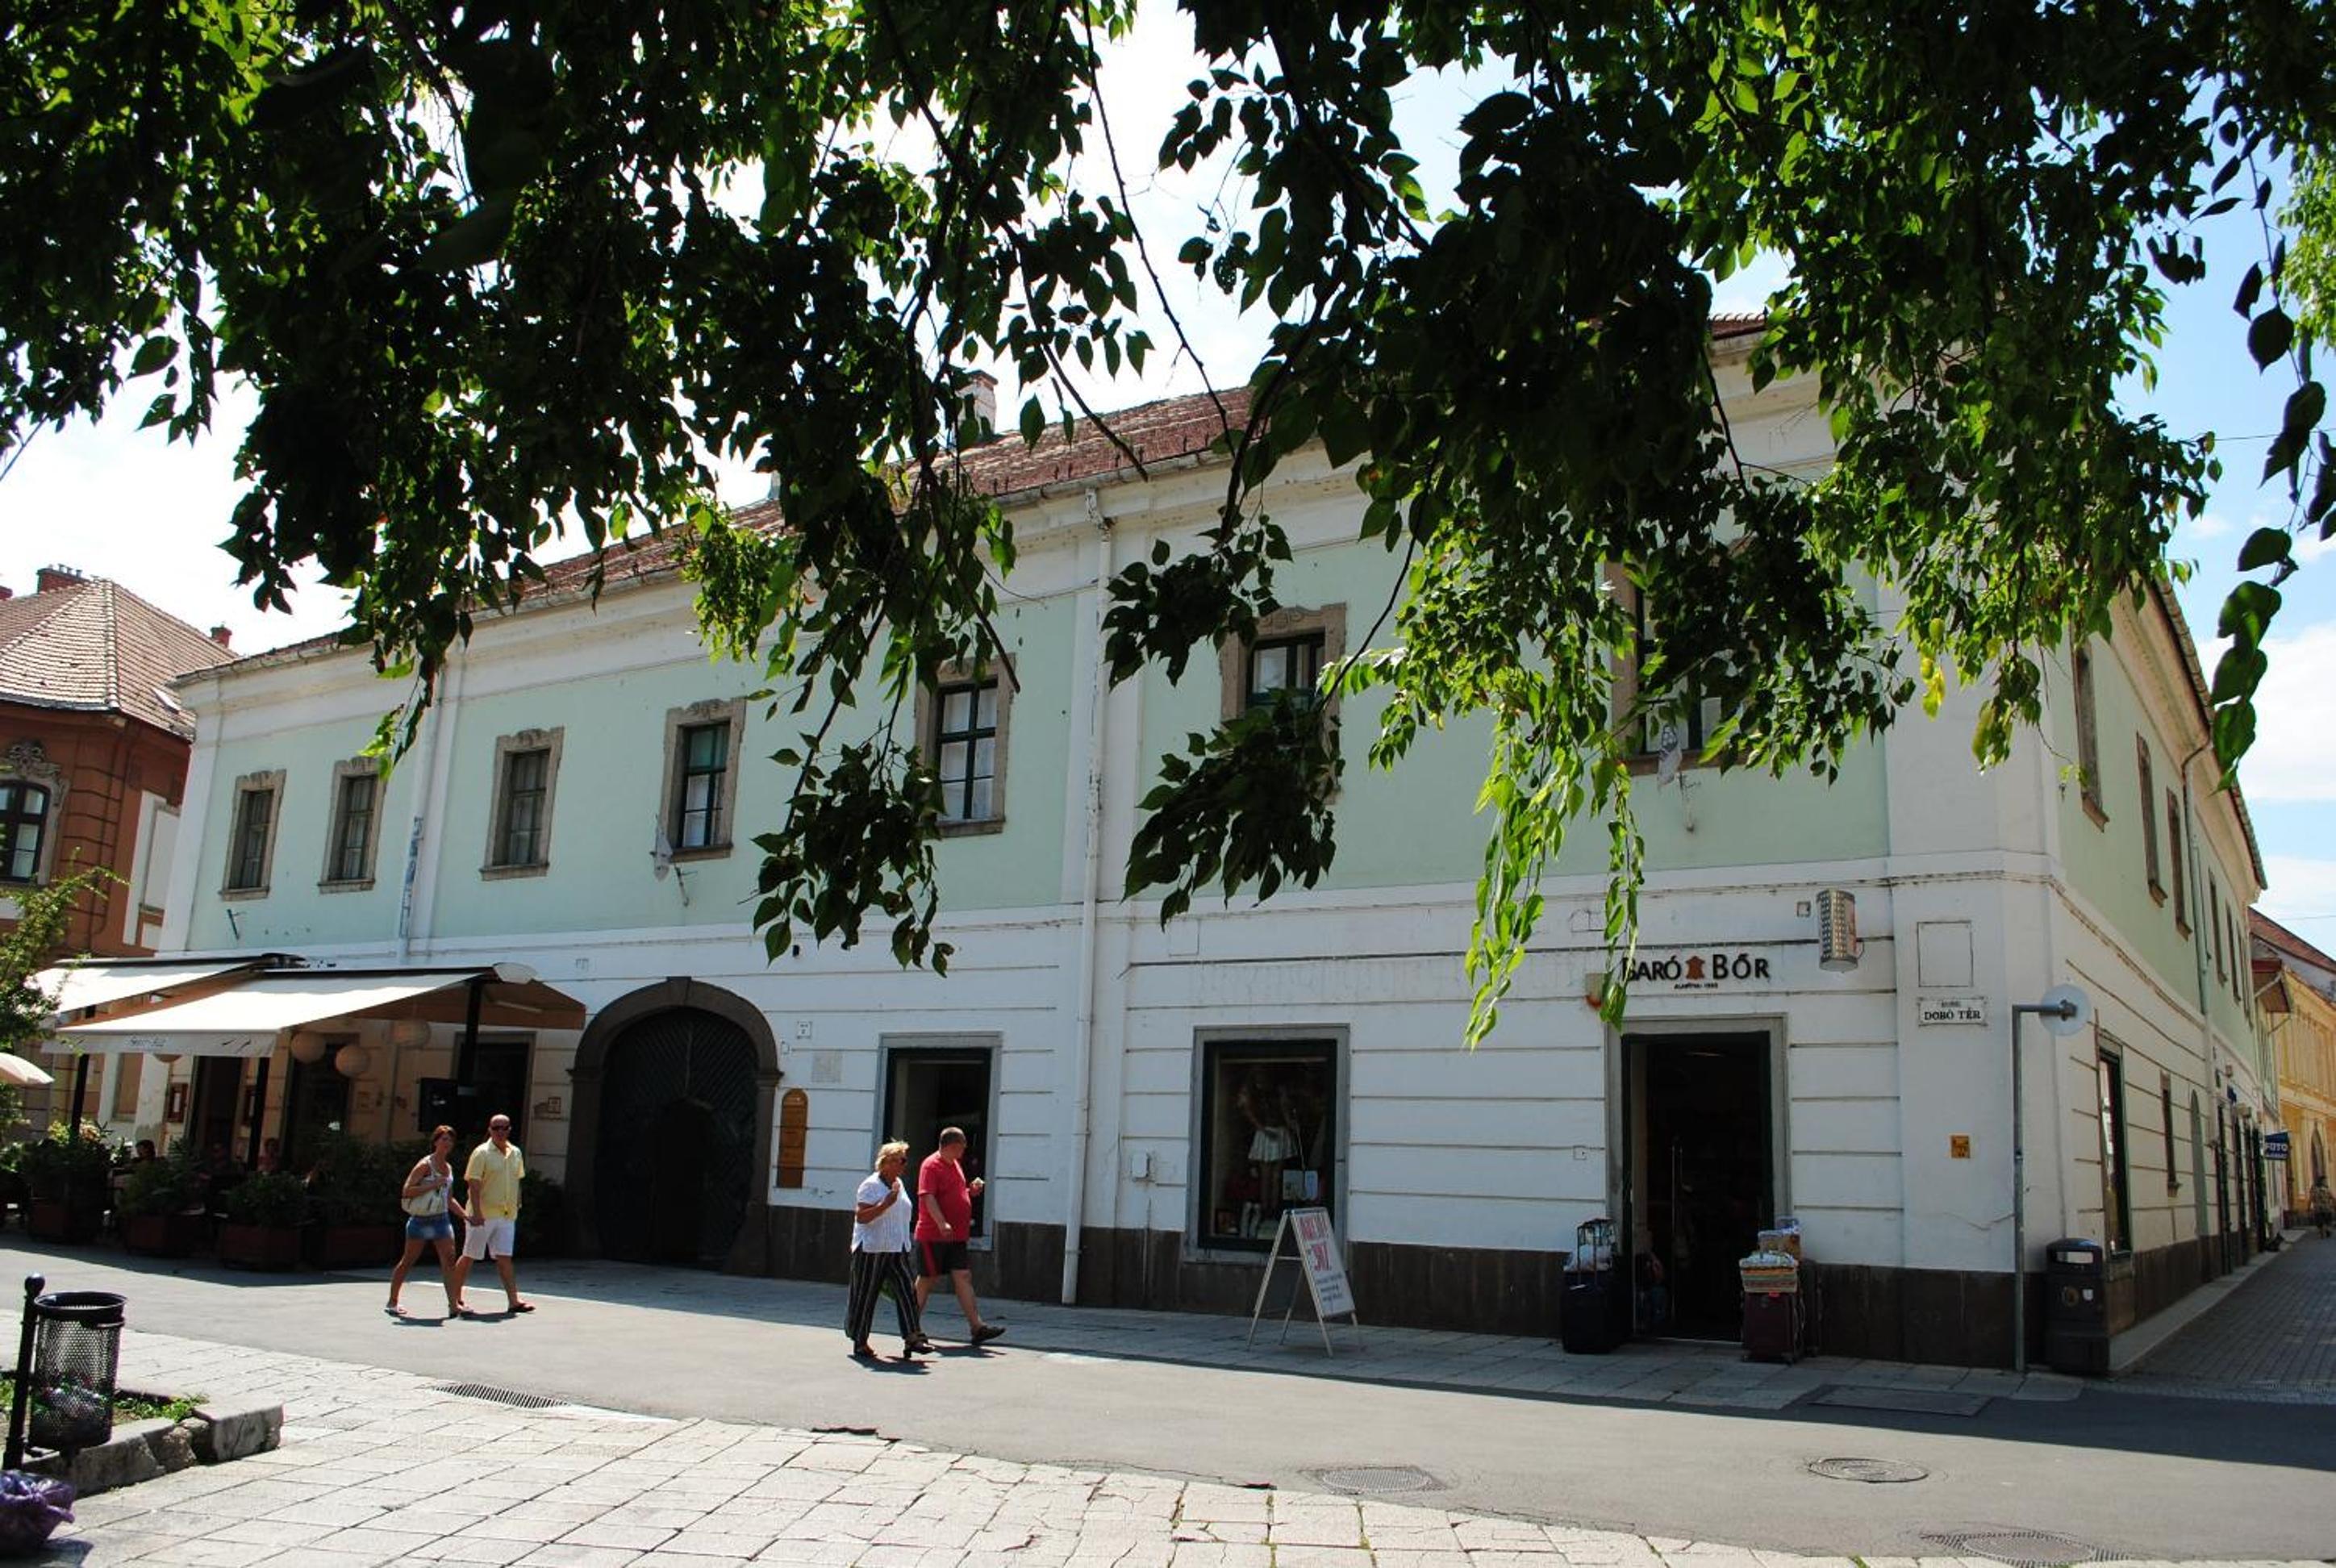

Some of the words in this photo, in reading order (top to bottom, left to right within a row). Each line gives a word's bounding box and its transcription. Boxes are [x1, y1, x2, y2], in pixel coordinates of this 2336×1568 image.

[1621, 955, 1682, 982] BARÓ
[1712, 953, 1770, 981] BŐR
[1924, 1009, 1954, 1020] DOBÓ
[1958, 1007, 1981, 1020] TÉR
